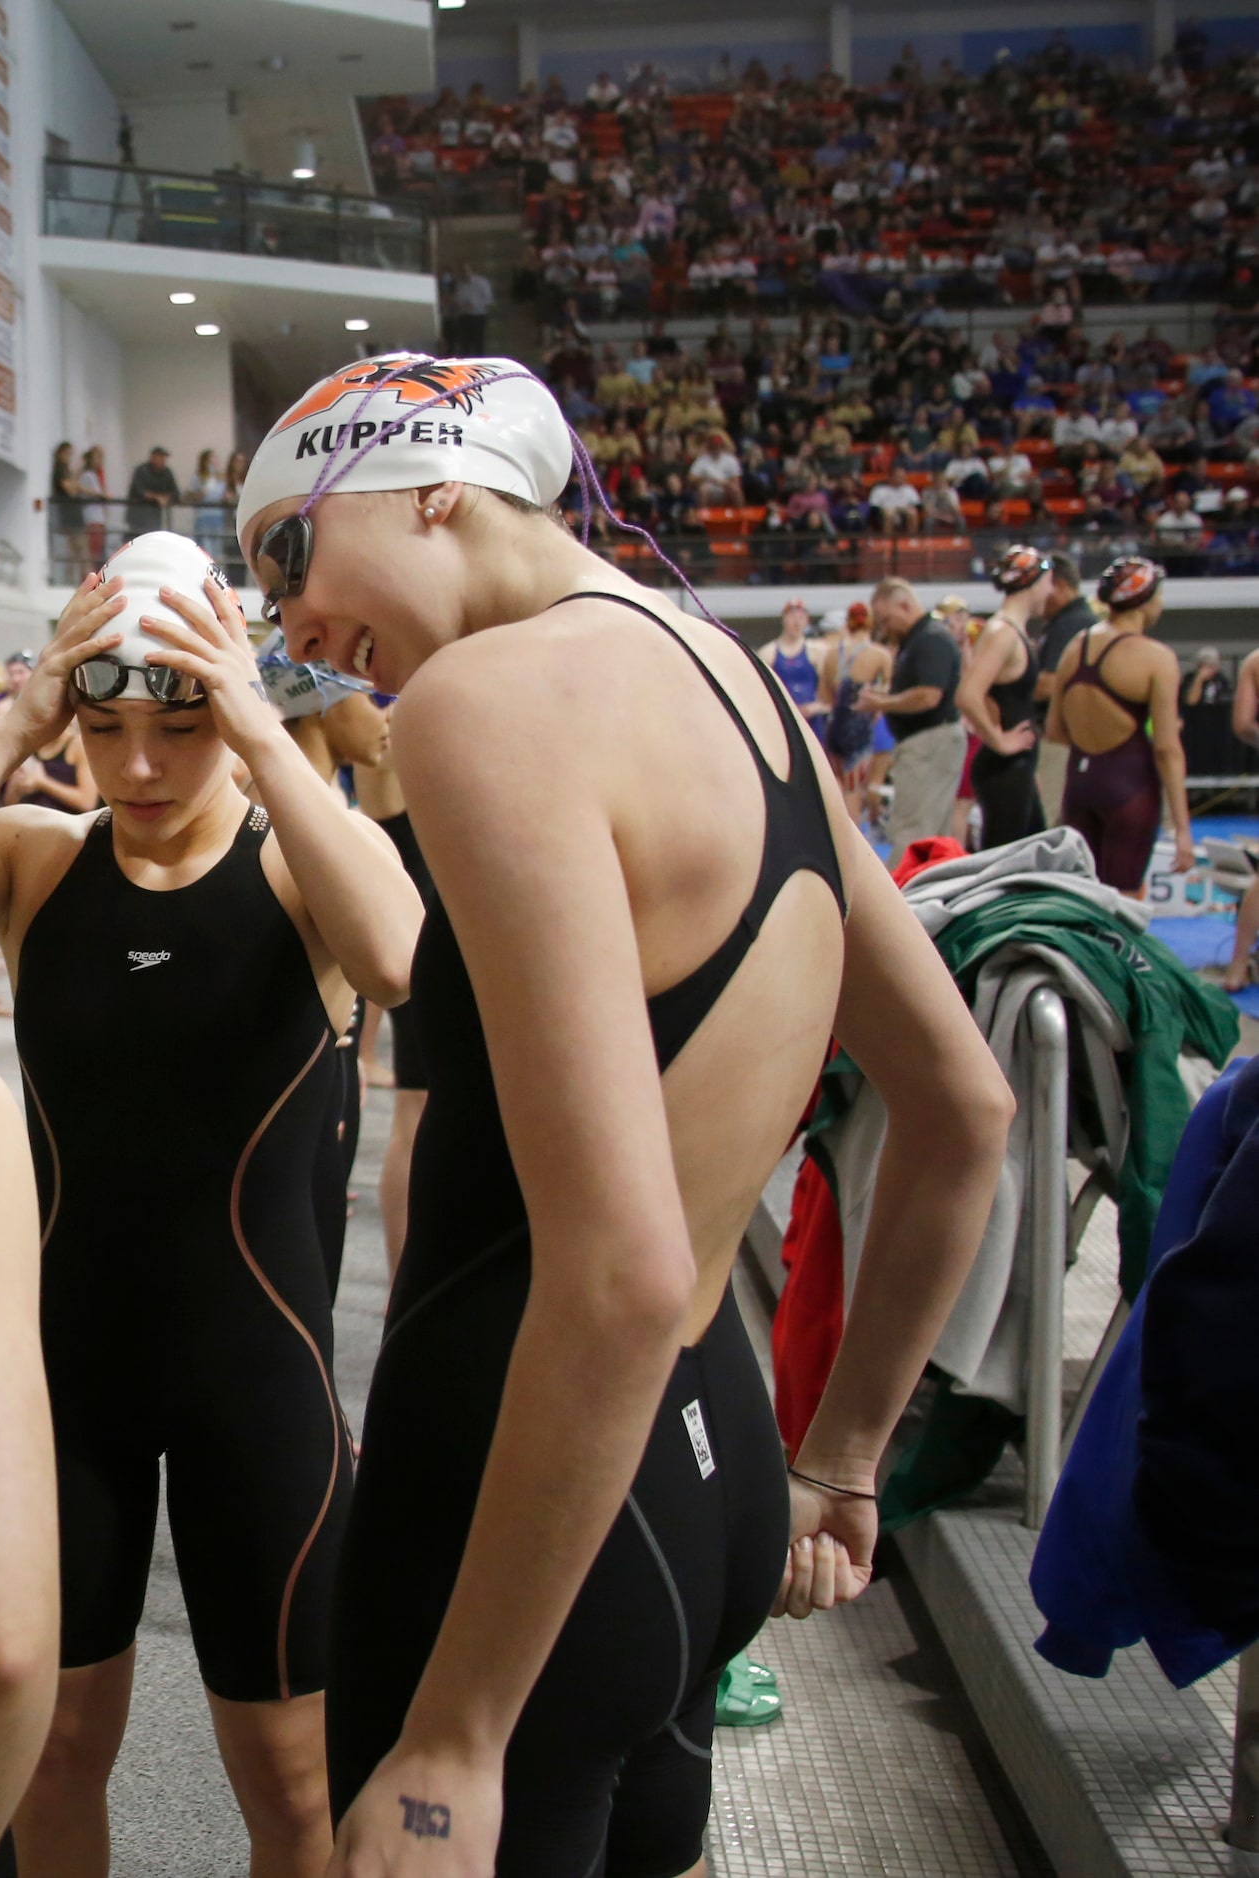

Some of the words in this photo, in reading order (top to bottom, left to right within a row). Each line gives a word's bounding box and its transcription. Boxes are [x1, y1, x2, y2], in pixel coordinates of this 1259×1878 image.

[295, 420, 463, 460] KUPPER
[1150, 873, 1173, 902] 5
[127, 950, 171, 961] speedo
